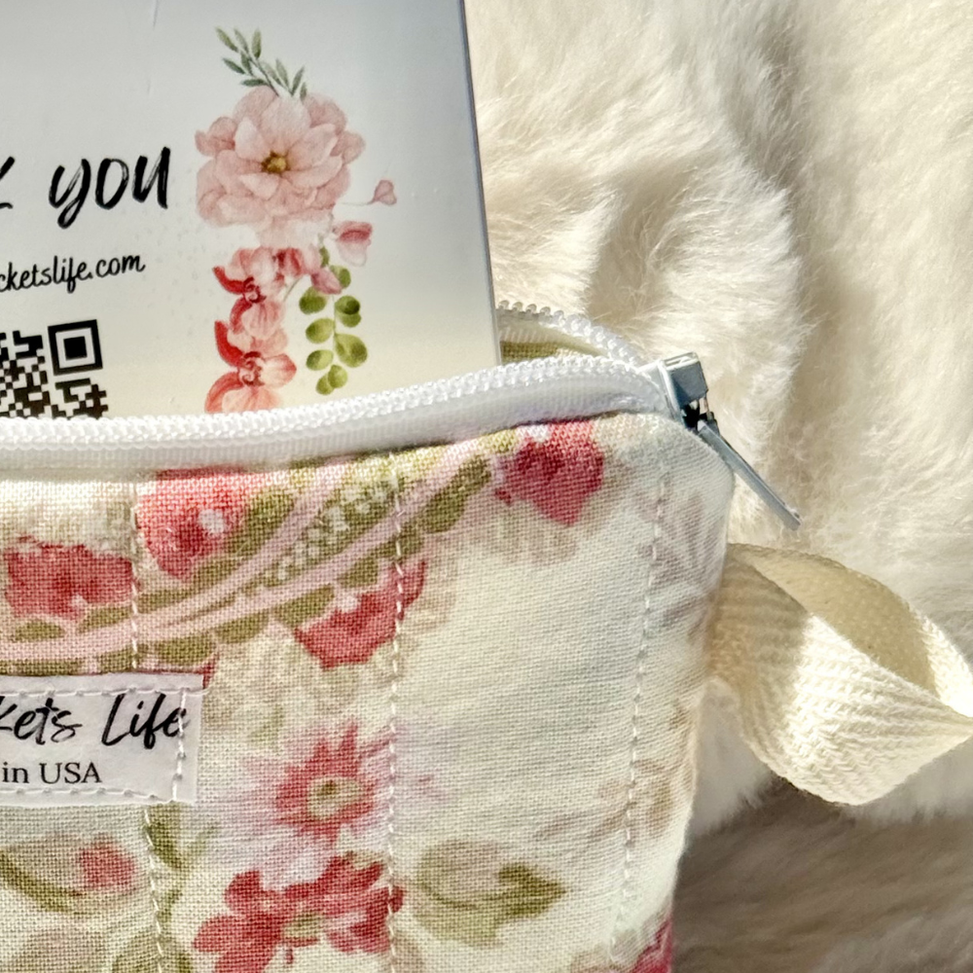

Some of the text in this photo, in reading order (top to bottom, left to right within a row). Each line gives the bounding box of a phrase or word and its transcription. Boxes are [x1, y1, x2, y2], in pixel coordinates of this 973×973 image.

[48, 146, 171, 229] you
[100, 692, 189, 749] Life
[2, 761, 29, 784] in
[39, 762, 103, 784] USA
